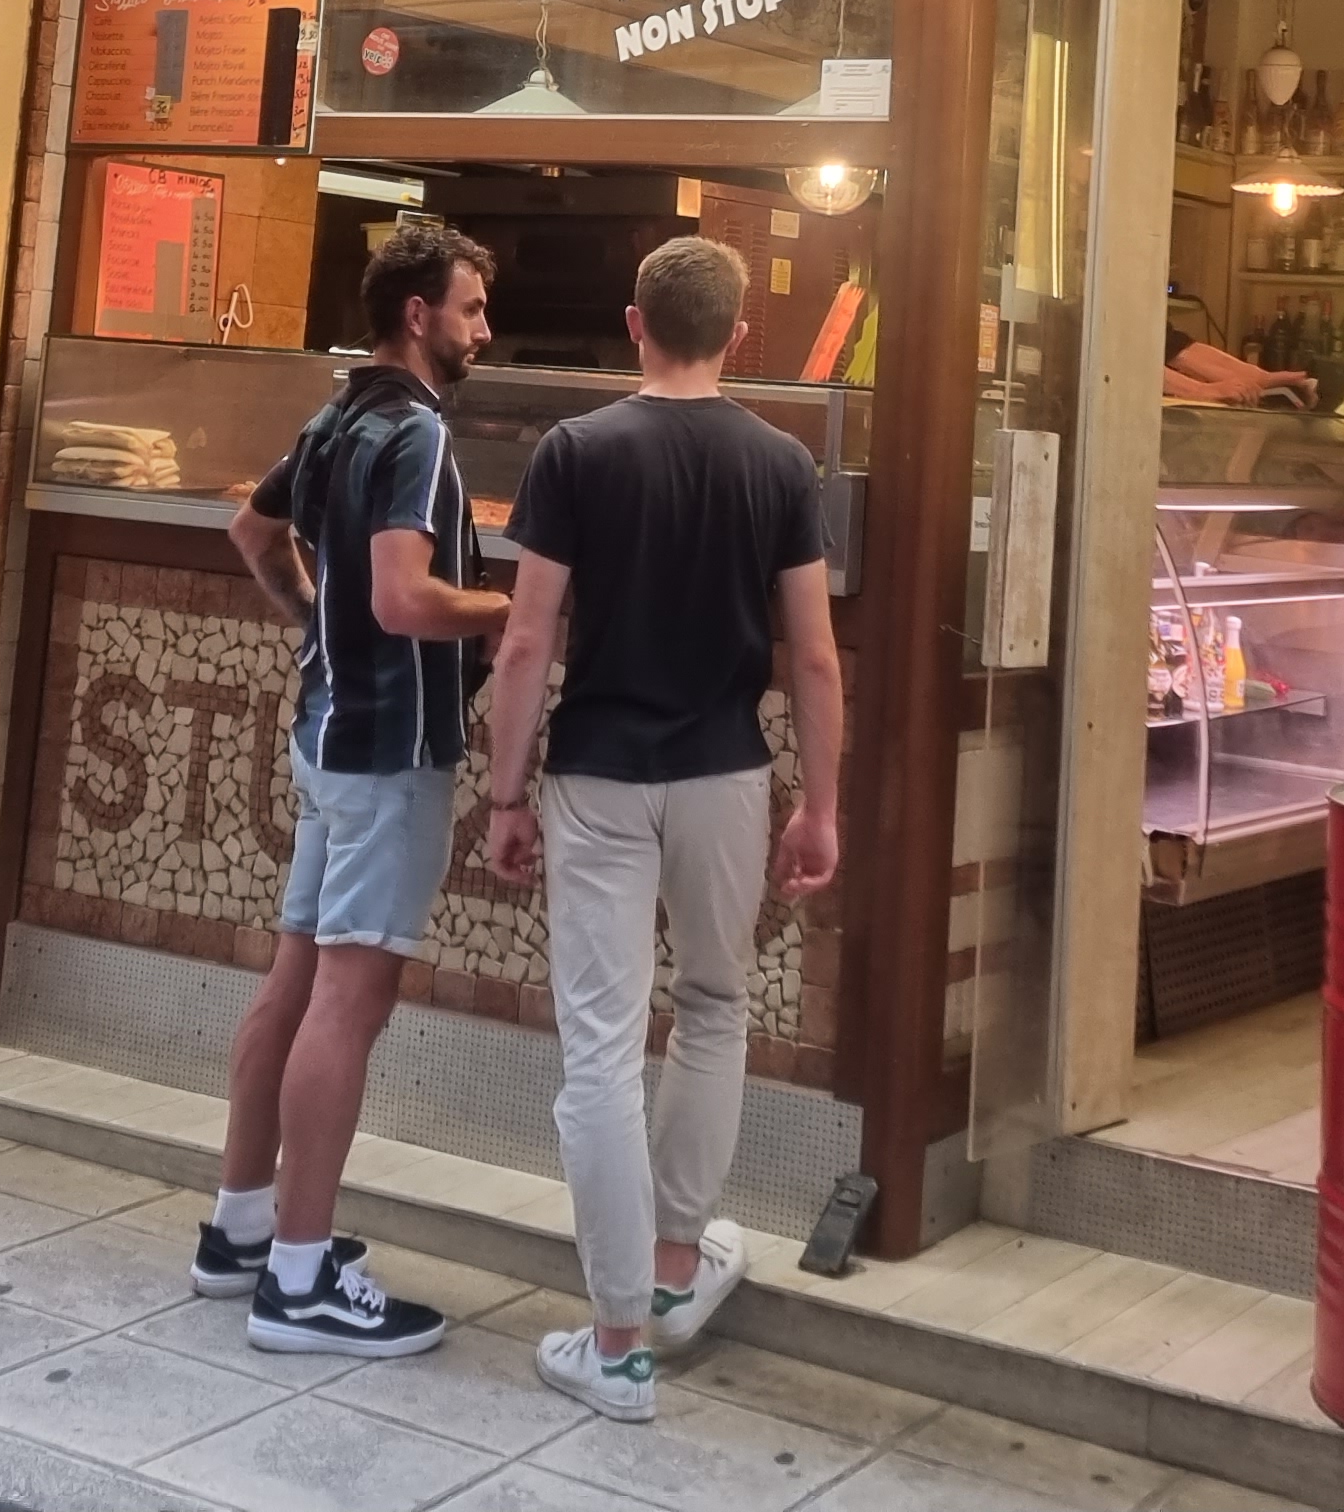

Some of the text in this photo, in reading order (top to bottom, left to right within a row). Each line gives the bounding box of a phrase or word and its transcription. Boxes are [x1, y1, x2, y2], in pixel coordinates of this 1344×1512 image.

[196, 31, 223, 41] Mojito
[615, 4, 695, 63] NON
[195, 46, 222, 56] Mojito
[194, 62, 220, 72] Mojito
